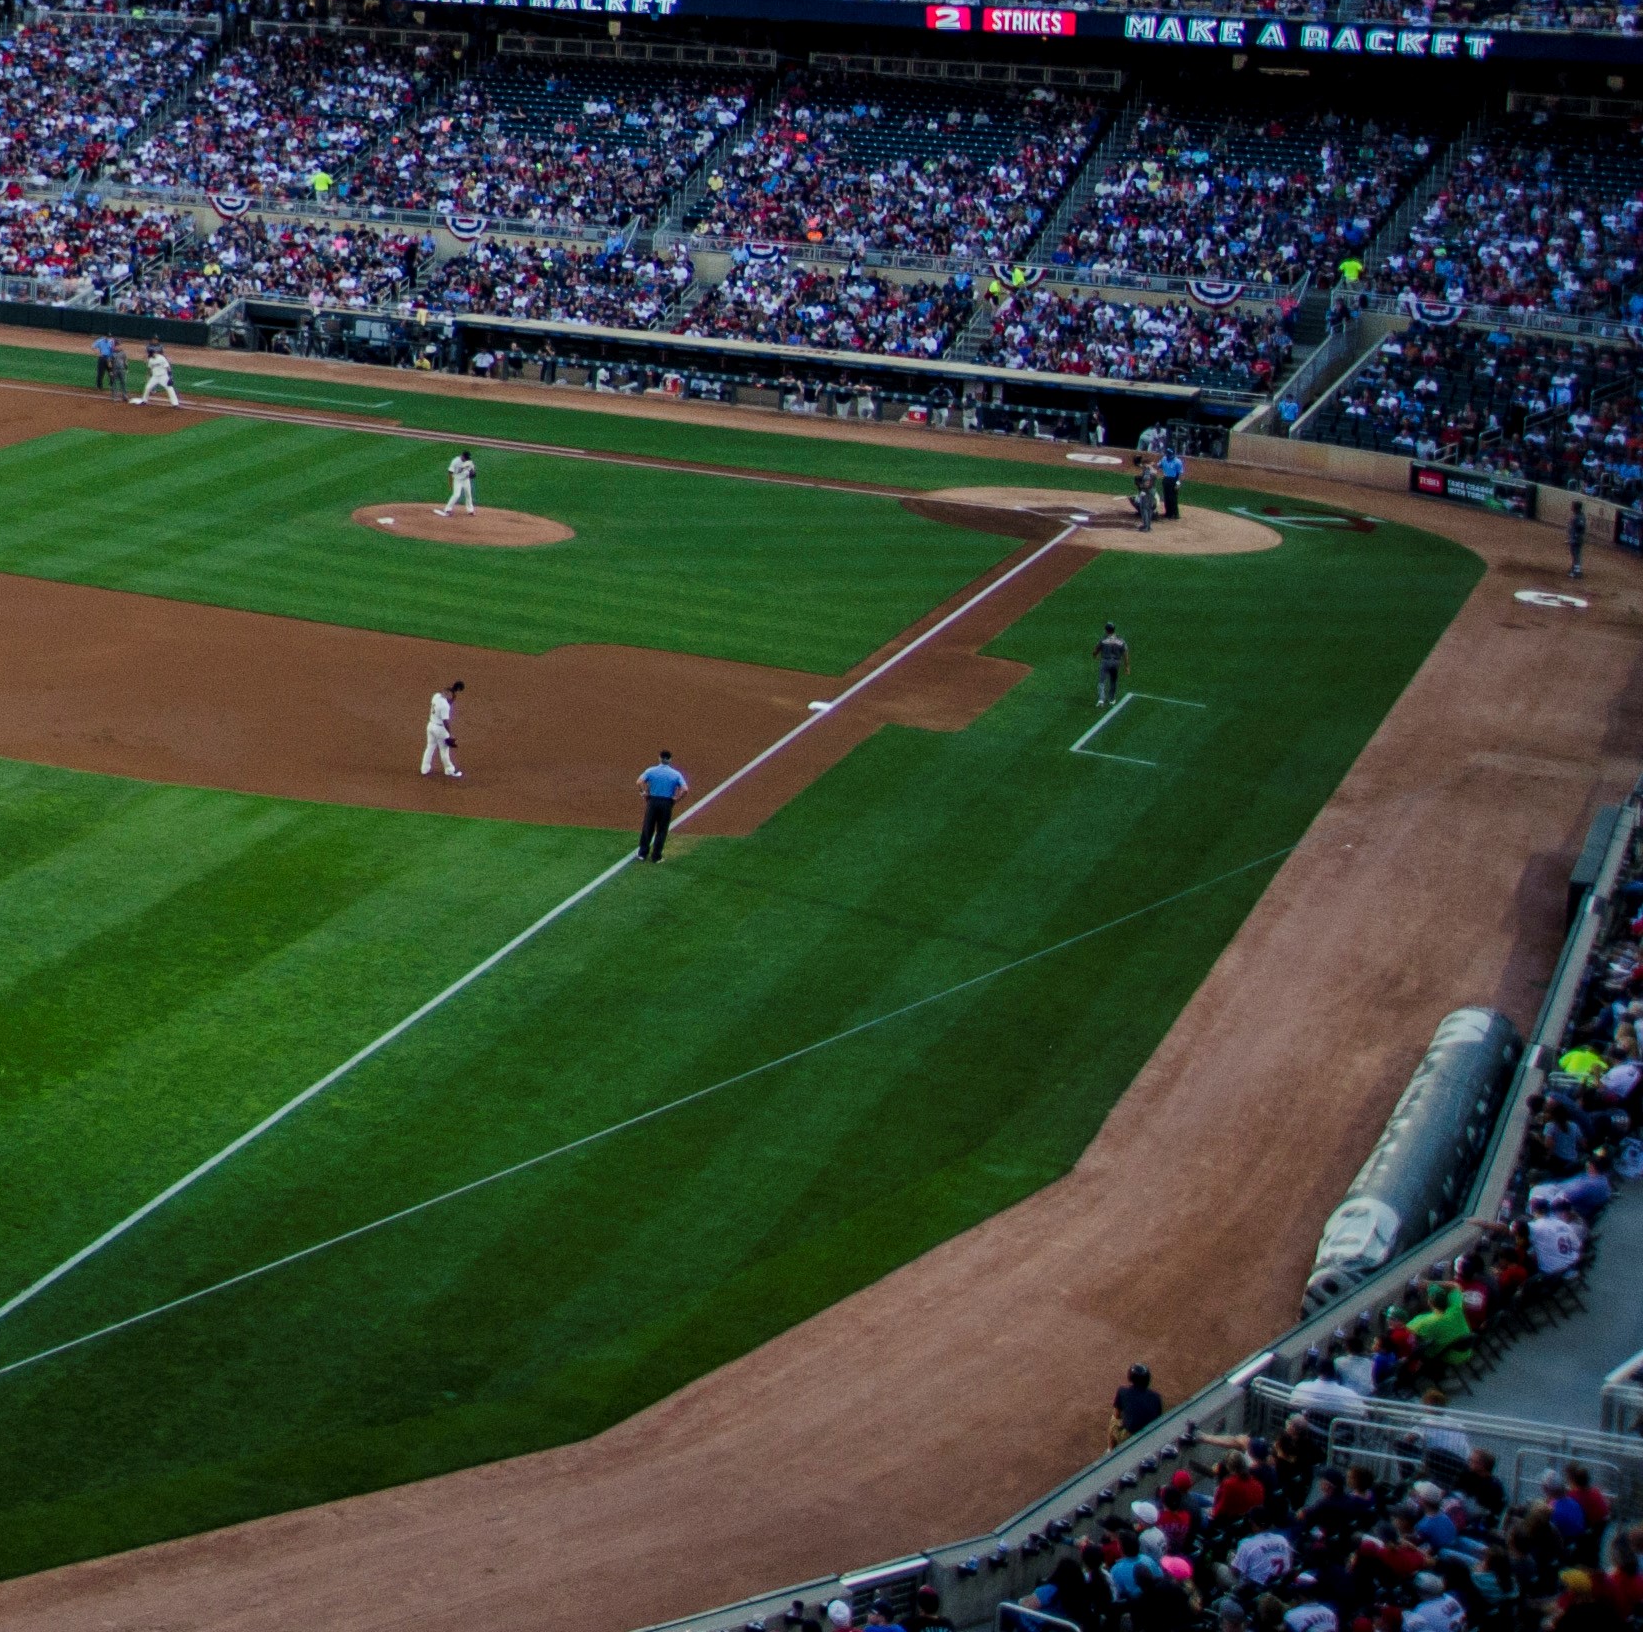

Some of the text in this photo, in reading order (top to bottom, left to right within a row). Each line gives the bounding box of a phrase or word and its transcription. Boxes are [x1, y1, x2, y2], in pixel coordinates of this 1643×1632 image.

[934, 8, 962, 29] 2
[990, 10, 1063, 34] STRIKES
[1124, 14, 1494, 58] MAKE A RACKET
